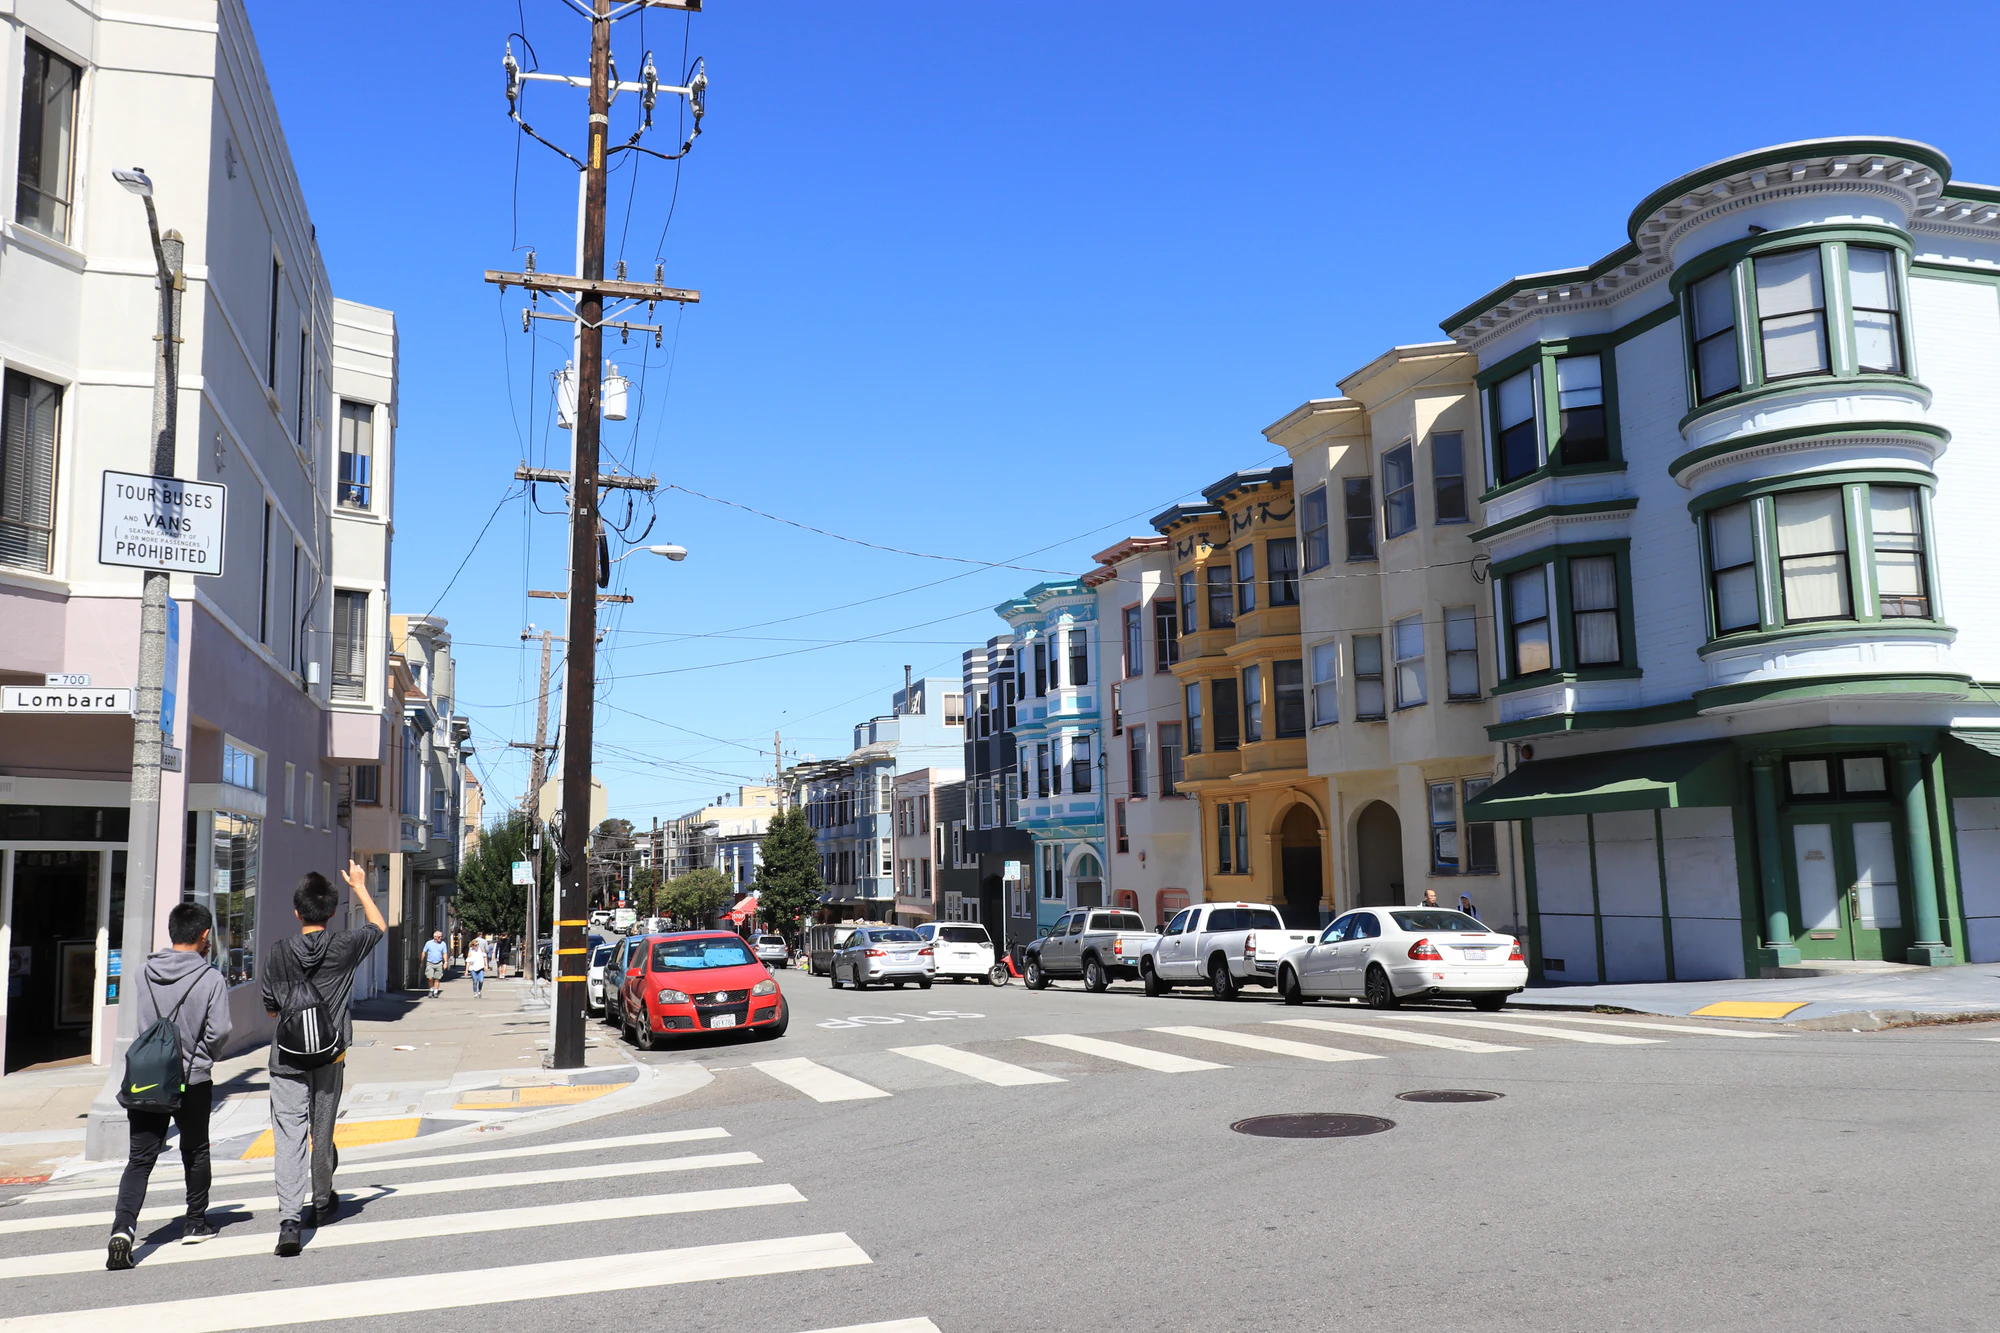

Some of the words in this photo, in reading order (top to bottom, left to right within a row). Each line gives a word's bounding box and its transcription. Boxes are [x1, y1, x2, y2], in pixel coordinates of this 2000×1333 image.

[116, 484, 156, 503] TOUR
[163, 489, 212, 509] BUSES
[143, 513, 192, 532] VANS
[129, 527, 155, 535] SEATING
[156, 530, 187, 540] CAPACITY
[160, 538, 200, 548] PASSENGERS
[116, 541, 206, 564] PROHIBITED
[62, 675, 85, 685] 700
[18, 692, 115, 708] Lombard
[163, 754, 176, 766] ason
